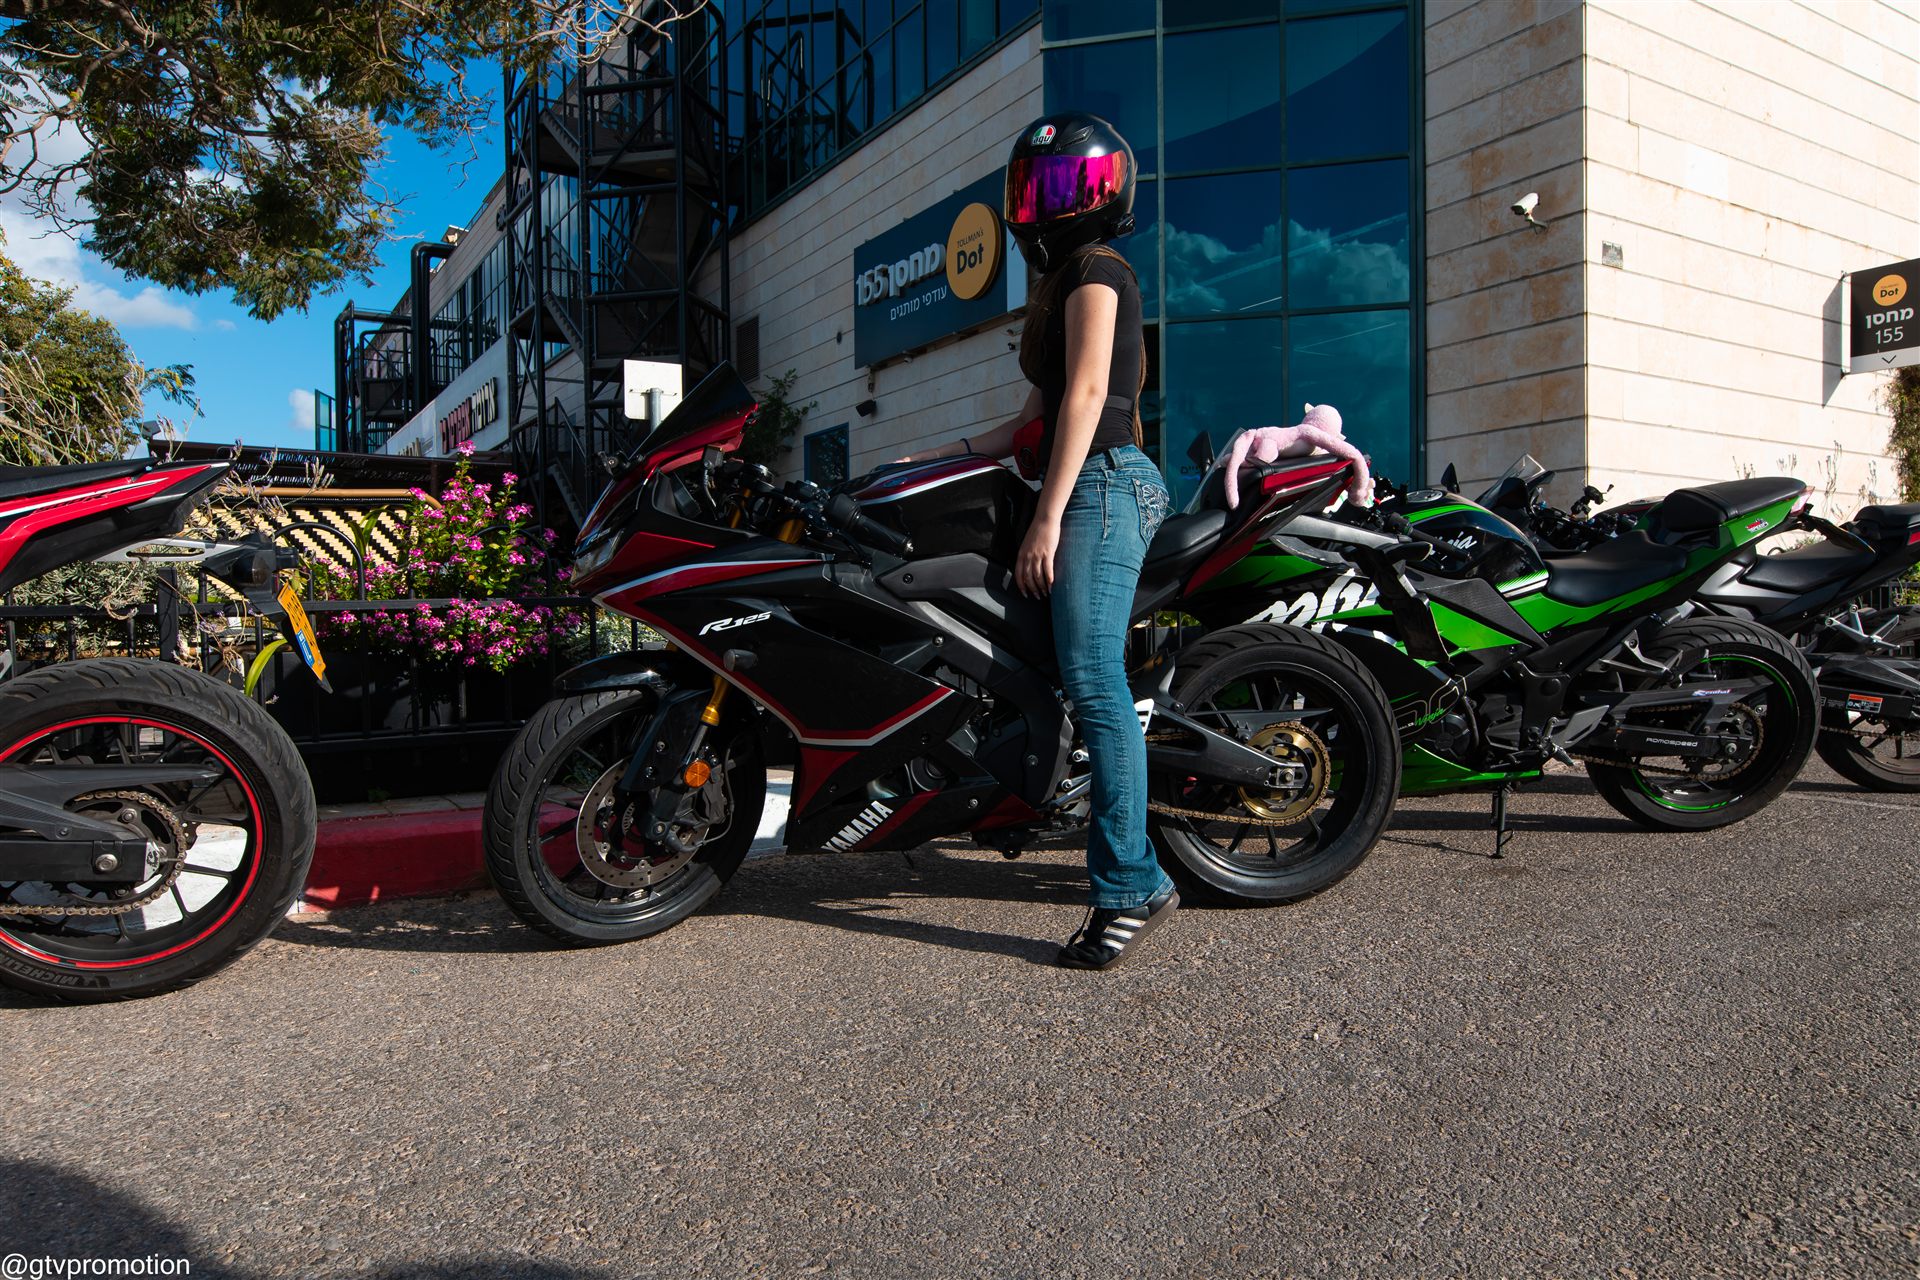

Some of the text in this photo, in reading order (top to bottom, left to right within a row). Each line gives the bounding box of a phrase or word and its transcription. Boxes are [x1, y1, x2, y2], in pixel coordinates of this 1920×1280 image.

[956, 243, 984, 275] Dot
[890, 285, 947, 321] עודפי מותגים
[1880, 288, 1899, 298] Dot
[1866, 307, 1914, 329] מחסן
[1875, 326, 1904, 344] 155
[699, 611, 772, 636] R125
[821, 800, 894, 853] YAMAHA
